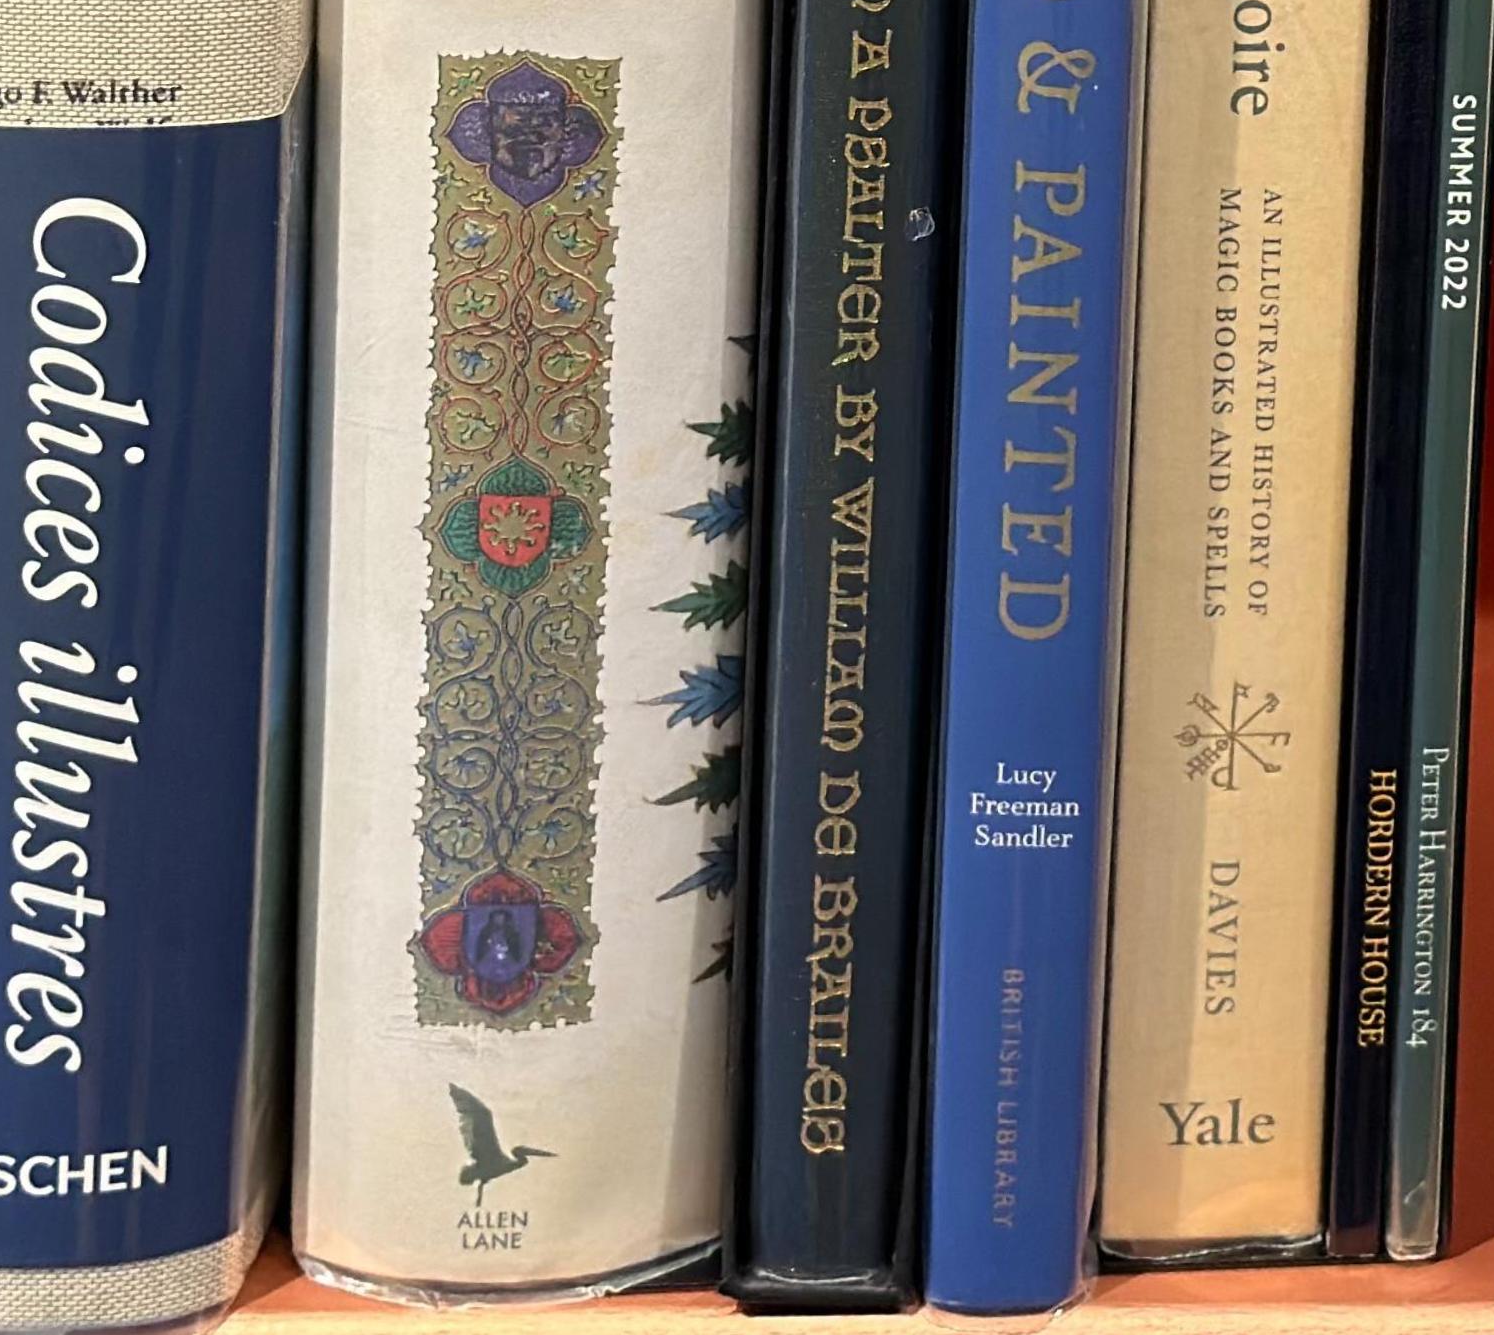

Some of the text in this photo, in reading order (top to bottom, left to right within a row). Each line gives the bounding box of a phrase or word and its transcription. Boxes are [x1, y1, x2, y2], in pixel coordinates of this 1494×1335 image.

[60, 79, 184, 106] Walther
[1018, 42, 1098, 113] &
[1441, 95, 1477, 310] SUMMER 2022
[22, 198, 149, 608] Codices
[999, 160, 1085, 640] PAINTED
[1204, 189, 1241, 617] MAGIC BOOKS AND SPELLS
[1248, 189, 1282, 615] AN ILLUSTRATED HISTORY OF
[970, 793, 1079, 816] Freeman
[997, 762, 1056, 793] Lucy
[5, 641, 139, 1072] illustres
[975, 825, 1073, 847] Sandler
[1203, 862, 1240, 1015] DAVIES
[1359, 769, 1397, 1046] HORDERN HOUSE
[1405, 1009, 1437, 1048] 184
[992, 968, 1024, 1228] BRITISH LIBRARY
[1159, 1099, 1275, 1145] Yale
[458, 1212, 528, 1228] ALLEN
[463, 1233, 521, 1250] LANE
